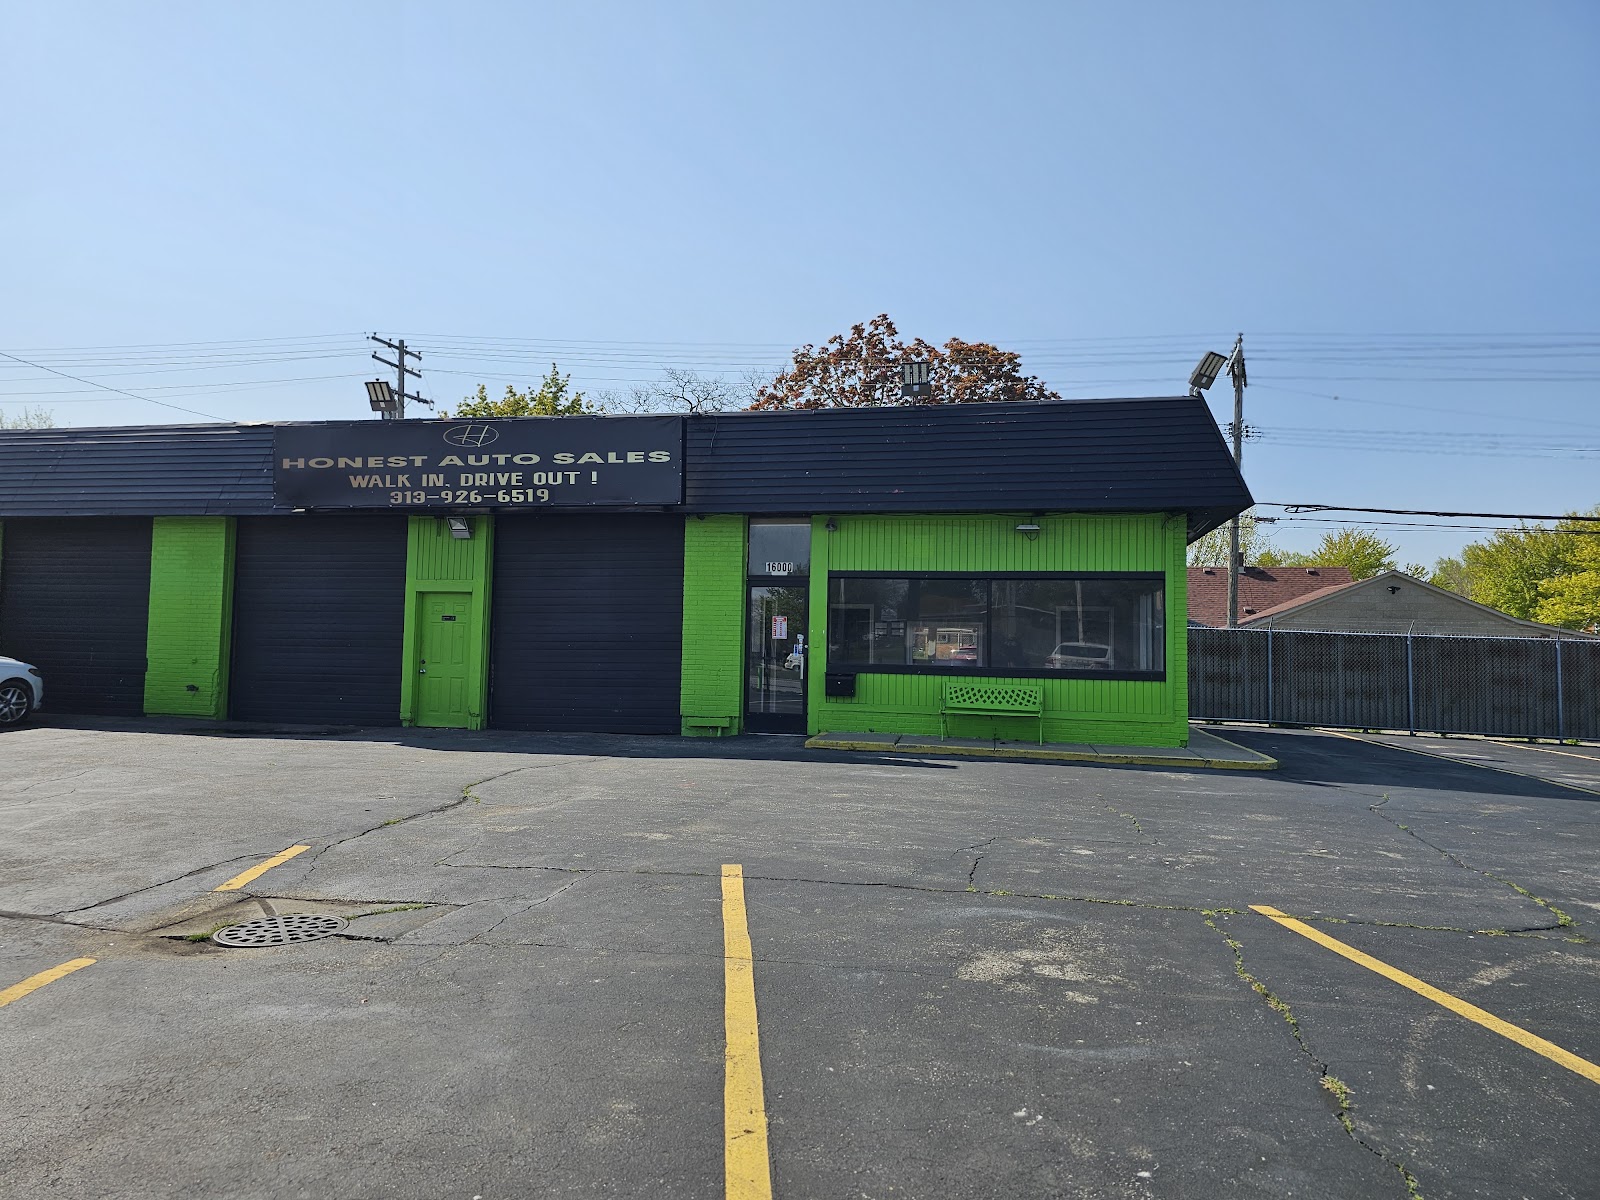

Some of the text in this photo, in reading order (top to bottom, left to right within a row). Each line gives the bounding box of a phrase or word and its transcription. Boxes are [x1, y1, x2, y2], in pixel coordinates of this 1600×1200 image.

[282, 451, 671, 469] HONEST AUTO SALES
[349, 474, 412, 488] WALK
[460, 472, 523, 487] DRIVE
[533, 471, 581, 485] OUT
[390, 488, 550, 504] 313-926-6519
[766, 562, 792, 572] 16000
